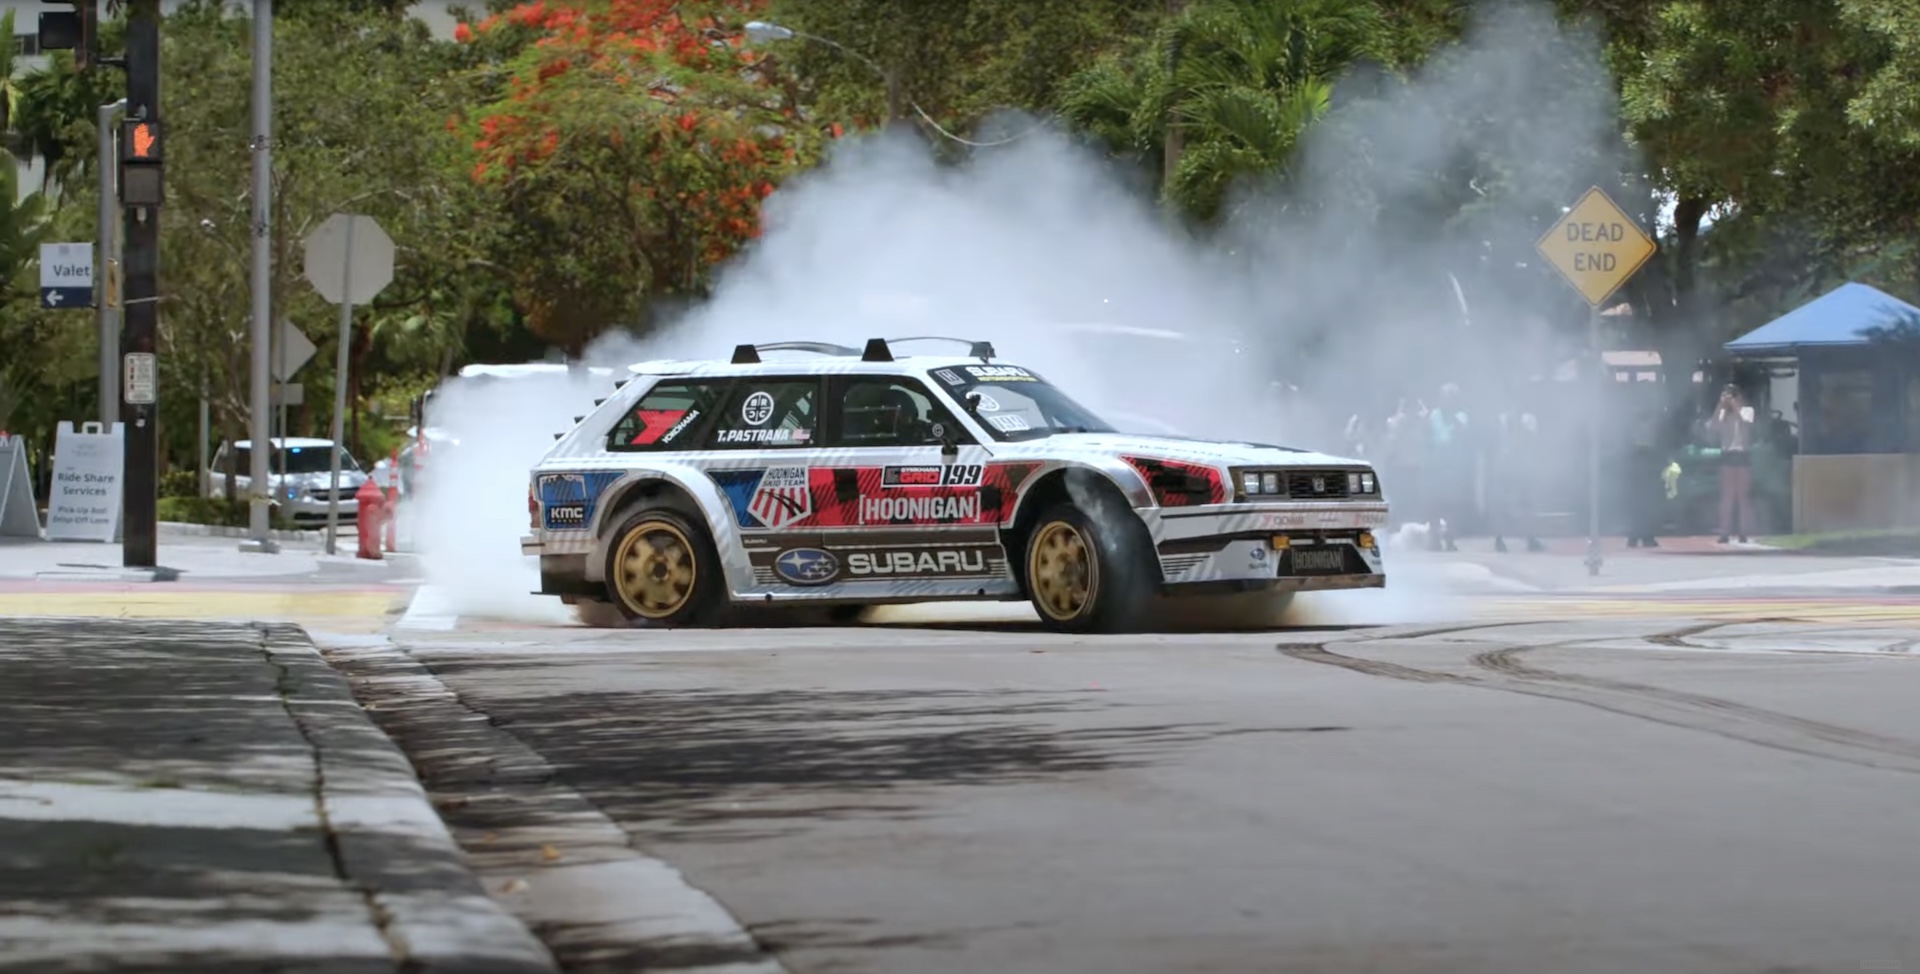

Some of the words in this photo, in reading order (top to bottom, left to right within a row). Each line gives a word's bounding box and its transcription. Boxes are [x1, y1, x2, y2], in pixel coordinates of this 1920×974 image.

[1567, 222, 1624, 242] DEAD
[1574, 252, 1617, 272] END
[53, 264, 91, 277] Valet
[965, 366, 1031, 377] SUBARU
[662, 409, 700, 444] YOKOHAMA
[717, 429, 790, 442] T.PASTRANA
[58, 472, 82, 482] Ride
[84, 473, 115, 483] Share
[768, 467, 806, 479] HOONIGAN
[901, 472, 940, 484] GRID
[942, 465, 982, 485] 199
[63, 487, 107, 496] Services
[551, 507, 583, 518] KMC
[847, 550, 983, 575] SUBARU
